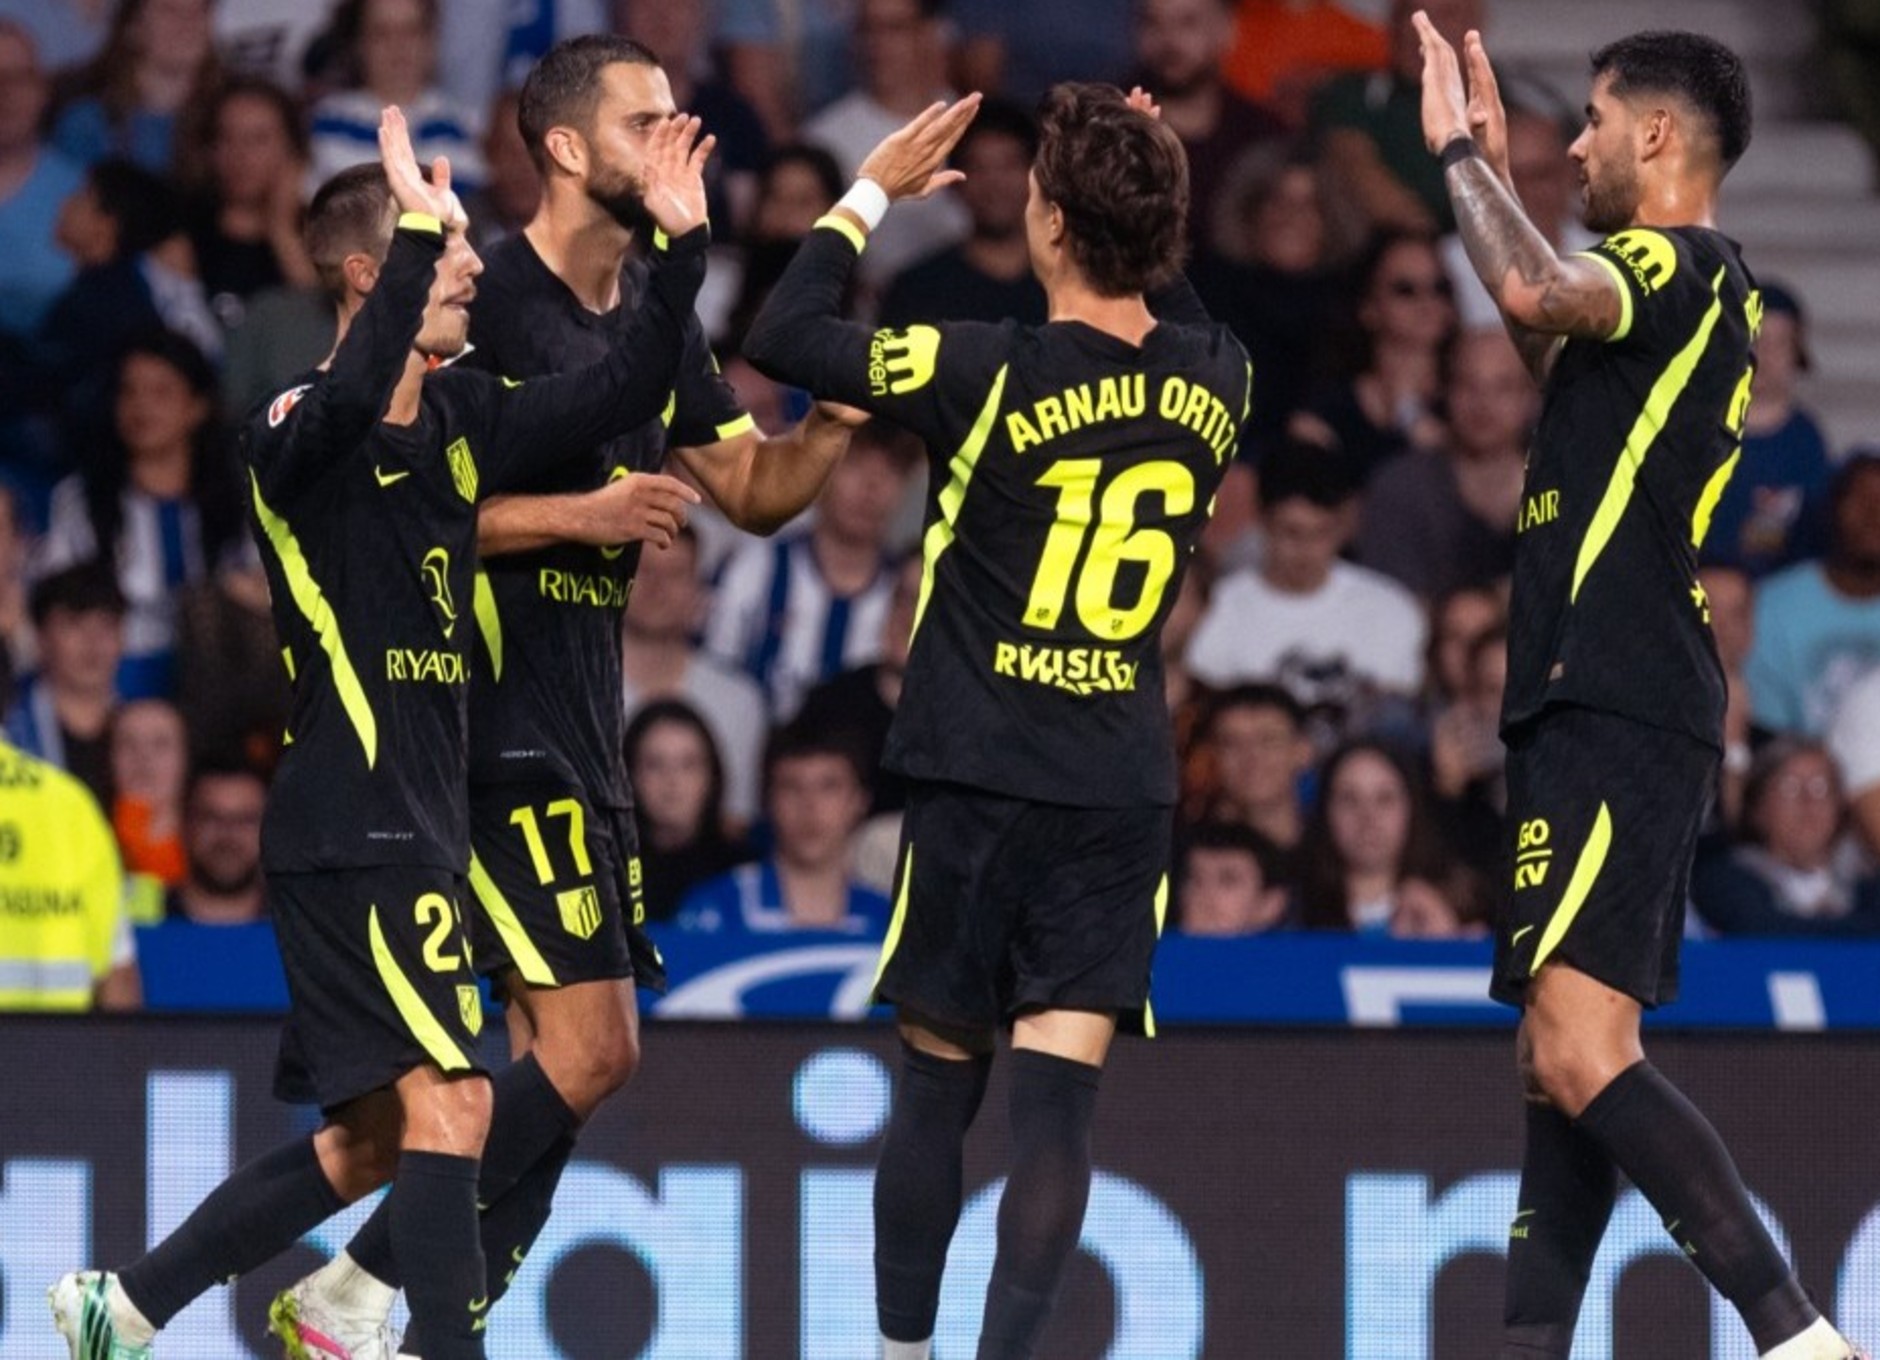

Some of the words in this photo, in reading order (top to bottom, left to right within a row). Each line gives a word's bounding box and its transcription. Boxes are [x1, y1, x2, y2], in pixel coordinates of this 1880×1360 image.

[1004, 373, 1146, 454] ARNAU
[1159, 376, 1236, 466] ORTIZ
[1022, 458, 1195, 641] 16
[1525, 489, 1559, 529] AIR
[509, 798, 593, 885] 17
[1517, 818, 1550, 850] GO
[414, 892, 473, 972] 2
